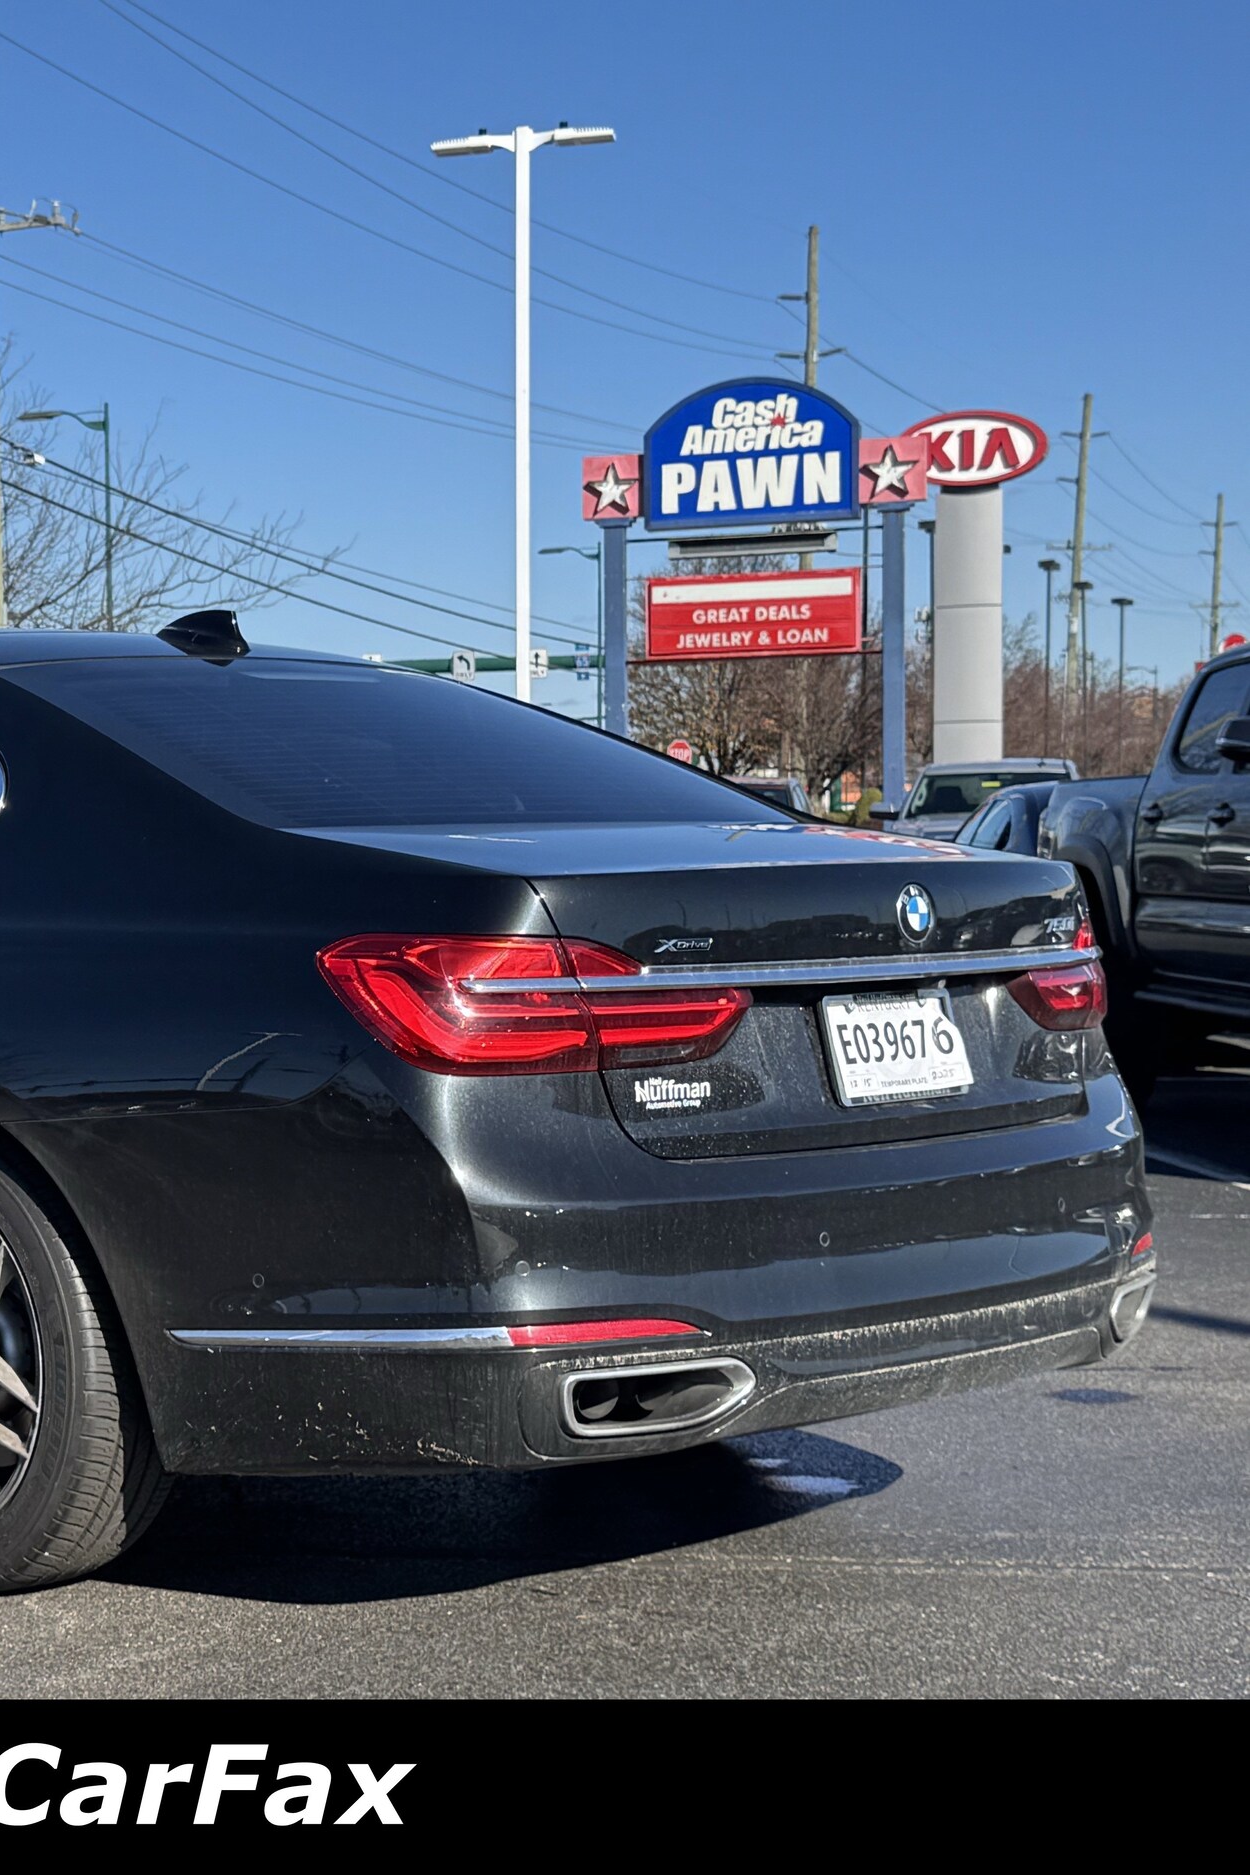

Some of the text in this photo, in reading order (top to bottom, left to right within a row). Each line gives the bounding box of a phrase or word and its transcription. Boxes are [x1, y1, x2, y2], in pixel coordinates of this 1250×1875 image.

[712, 394, 799, 429] Cash
[679, 420, 825, 456] America
[919, 427, 1021, 472] KIA
[661, 451, 841, 515] PAWN
[692, 604, 812, 625] GREAT DEALS
[676, 627, 830, 649] JEWELRY & LOAN
[837, 1016, 954, 1065] E039676
[682, 1098, 701, 1108] Group
